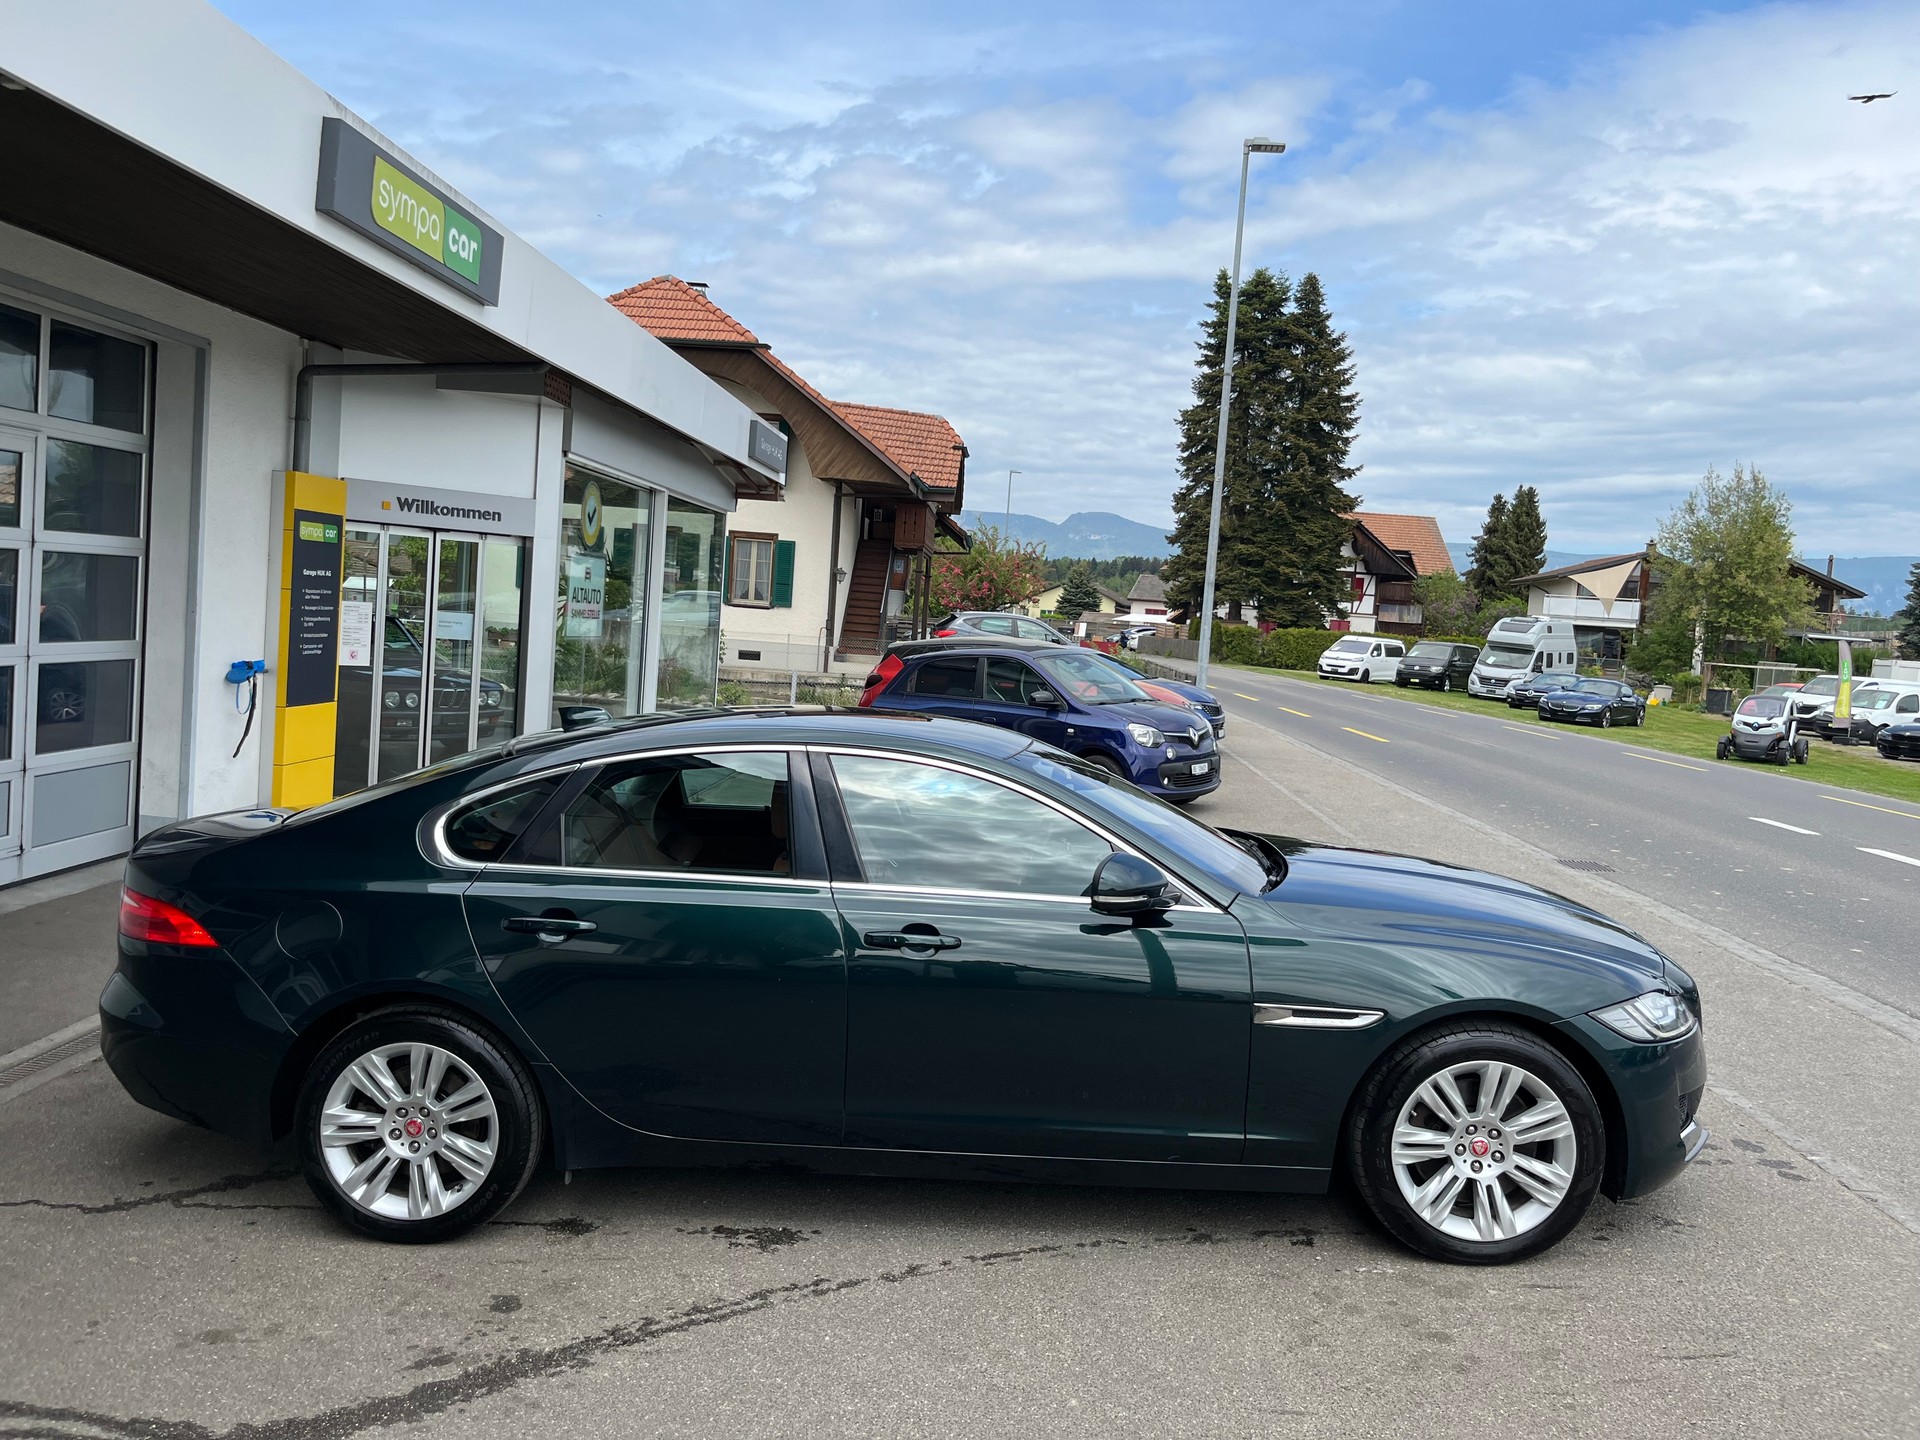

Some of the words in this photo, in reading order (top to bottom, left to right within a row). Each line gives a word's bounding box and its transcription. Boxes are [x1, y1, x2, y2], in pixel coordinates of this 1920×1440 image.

[379, 179, 440, 242] sympa
[448, 227, 478, 263] car
[396, 496, 502, 522] Willkommen
[301, 527, 323, 538] sympa
[325, 529, 337, 538] car
[572, 587, 601, 605] ALTAUTO
[571, 608, 601, 620] SAMMELSTELLE
